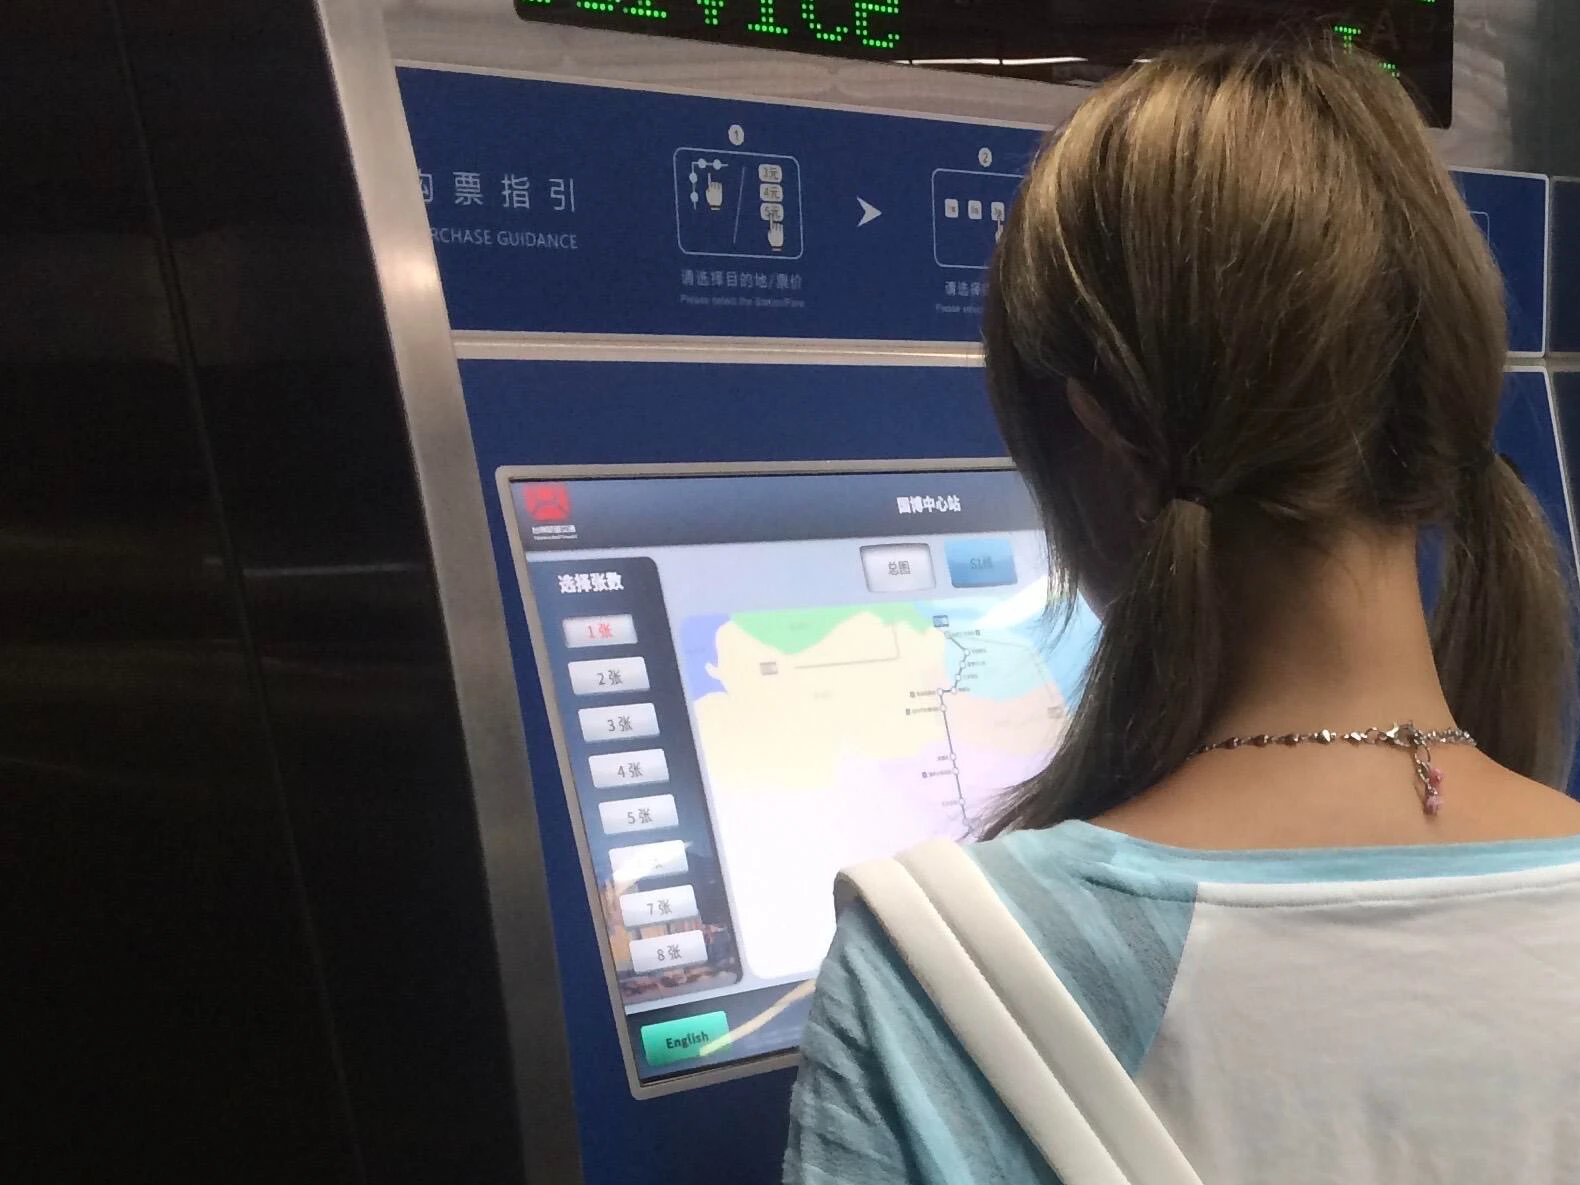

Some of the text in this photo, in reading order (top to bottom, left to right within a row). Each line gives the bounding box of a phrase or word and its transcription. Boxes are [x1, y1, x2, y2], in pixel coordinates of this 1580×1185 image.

[430, 226, 579, 249] RCHASE GUIDANCE
[557, 571, 624, 594] 选择张数
[665, 1030, 709, 1050] English
